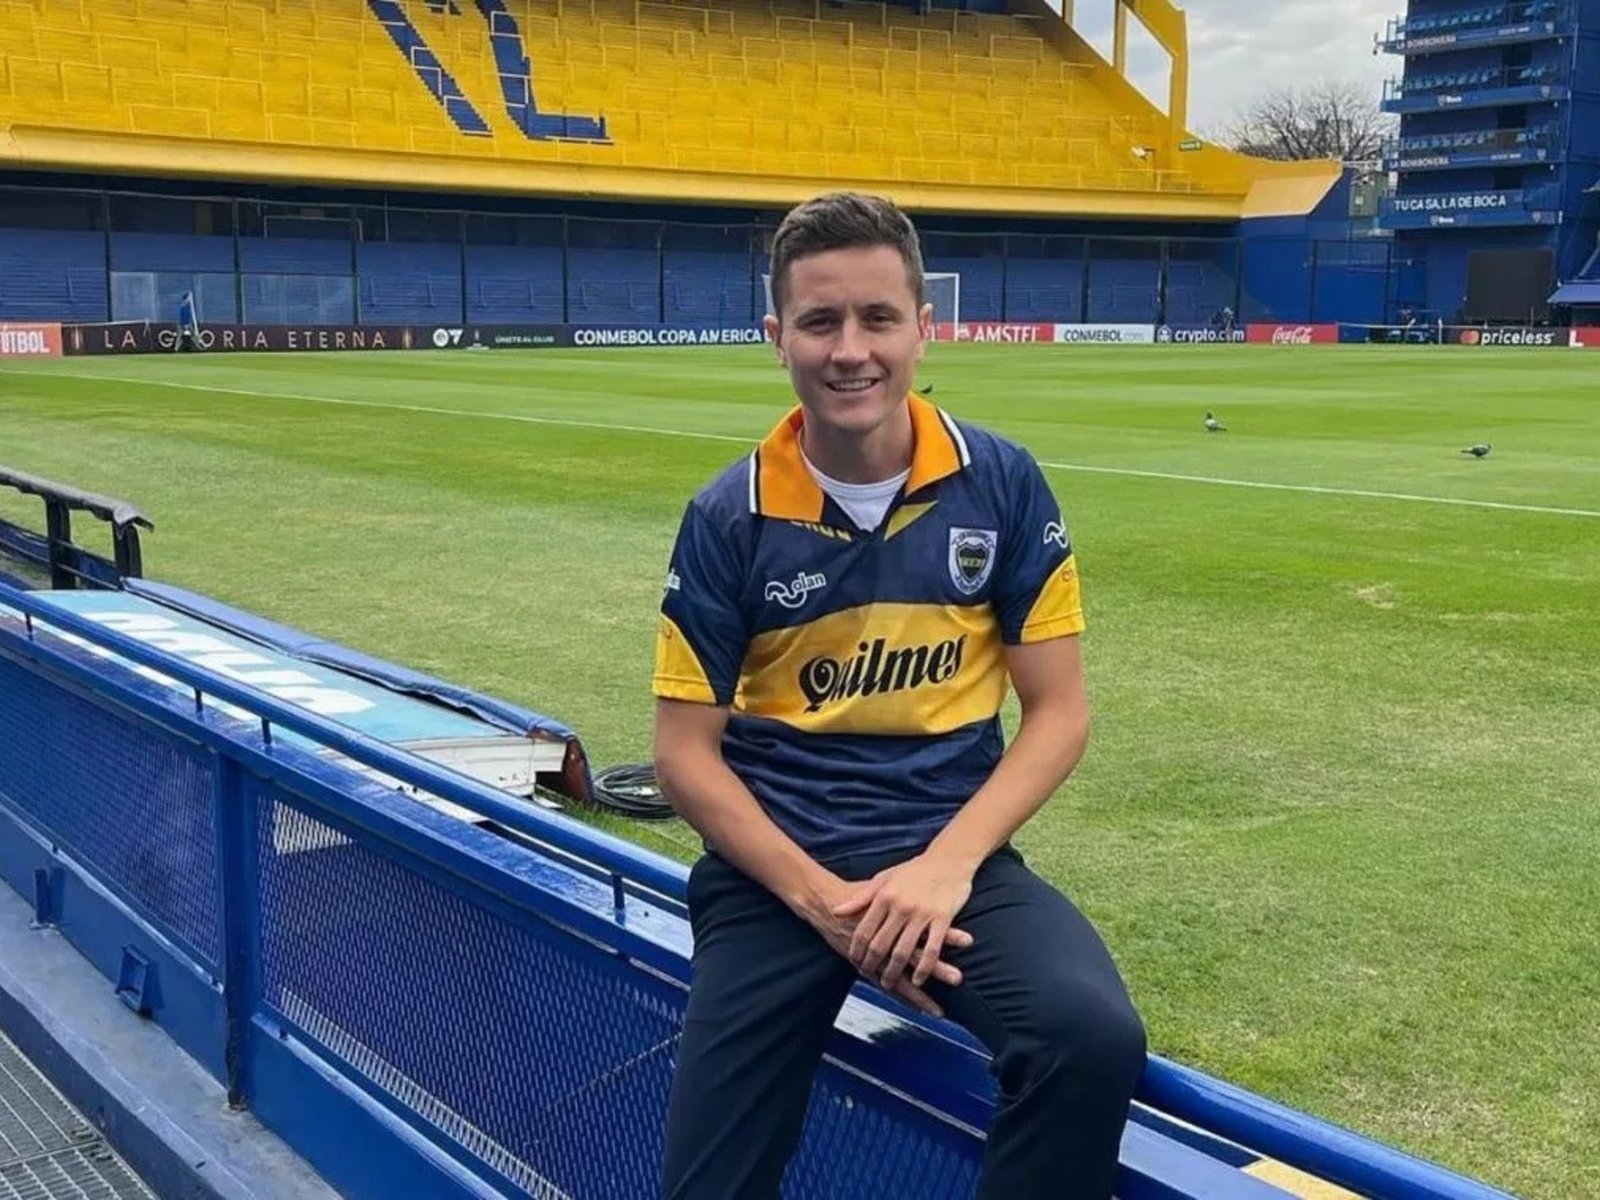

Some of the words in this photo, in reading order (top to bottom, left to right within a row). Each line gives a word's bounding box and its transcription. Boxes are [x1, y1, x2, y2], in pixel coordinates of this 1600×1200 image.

[1394, 200, 1409, 211] TU
[1442, 198, 1457, 209] LA
[1458, 197, 1472, 208] DE
[1474, 195, 1506, 207] BOCA
[104, 330, 136, 348] LA
[158, 329, 269, 348] GORIA
[287, 330, 386, 348] ETERNA
[574, 329, 656, 346] CONMEBOL
[658, 329, 697, 344] COPA
[700, 328, 762, 343] AMERICA
[1175, 326, 1245, 344] crypto.cm
[1481, 329, 1555, 346] priceless
[798, 634, 968, 713] Quilmes
